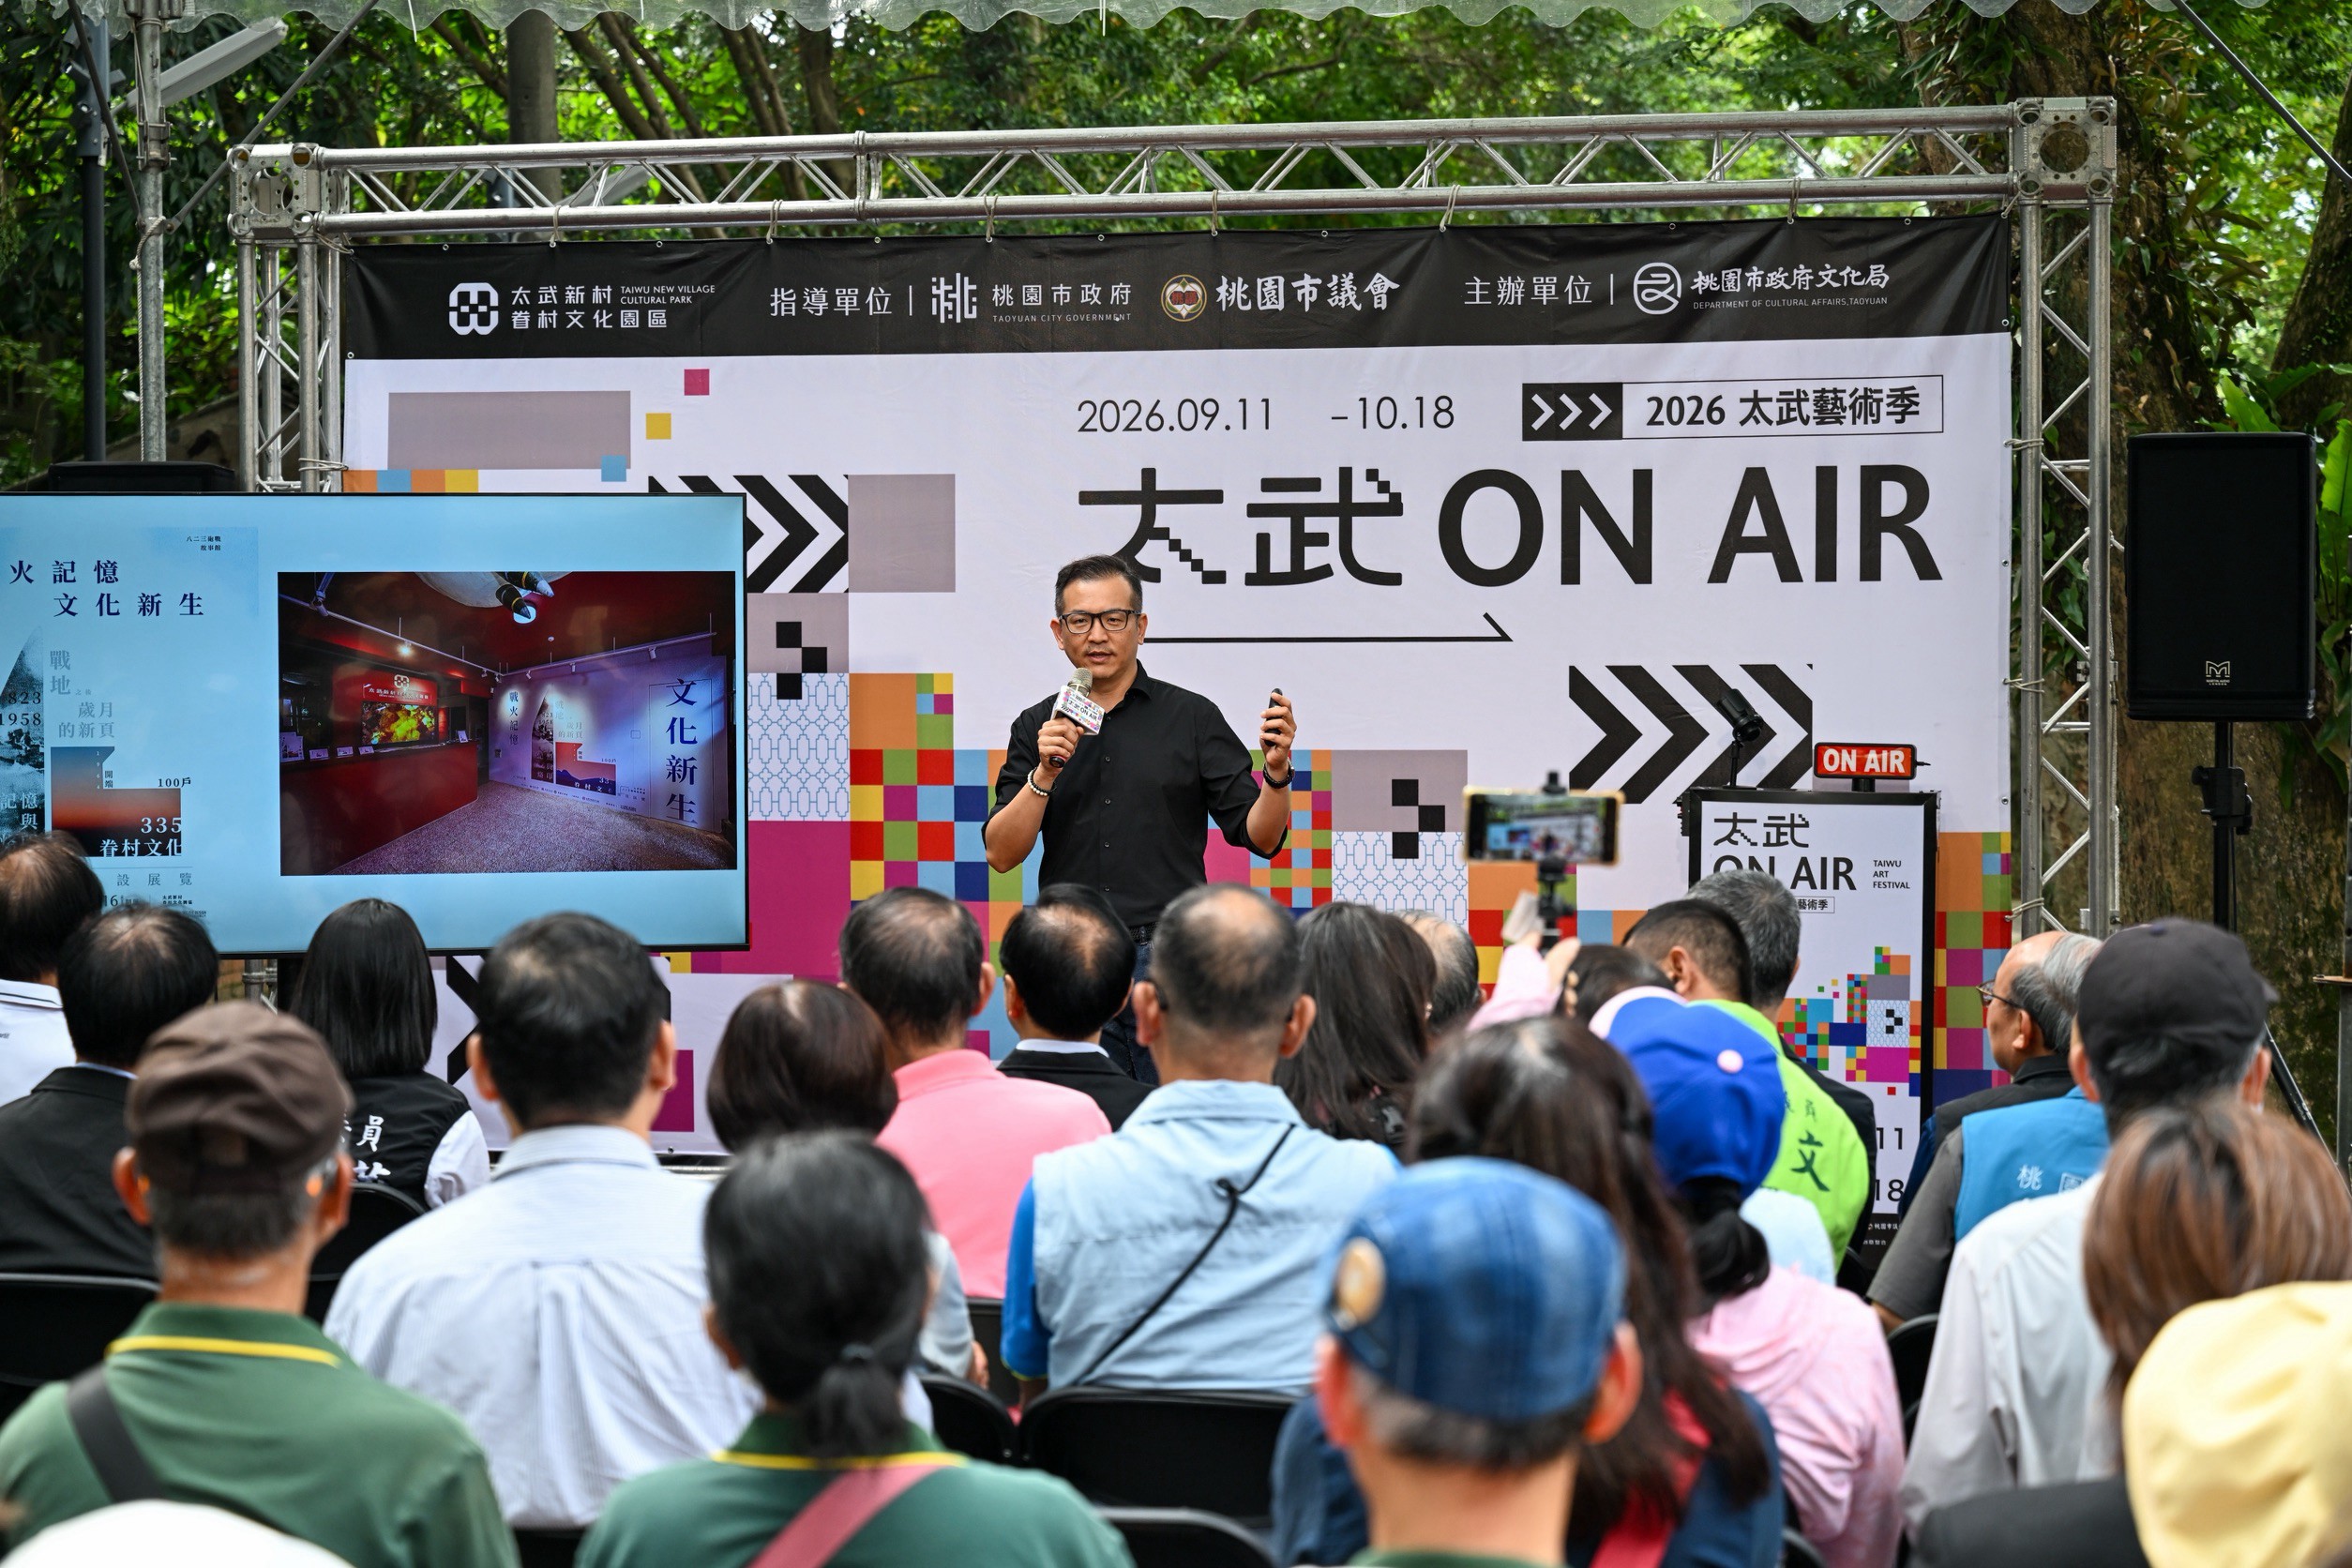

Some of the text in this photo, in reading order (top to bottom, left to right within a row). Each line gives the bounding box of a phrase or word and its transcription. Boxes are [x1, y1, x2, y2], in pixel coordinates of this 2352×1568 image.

[621, 284, 716, 294] TAIWU NEW VILLAGE
[1215, 272, 1400, 312] 桃園市議會
[1464, 276, 1592, 306] 主辦單位
[1690, 264, 1890, 295] 桃園市政府文化局
[511, 285, 612, 305] 太武新村
[620, 295, 693, 305] CULTURAL PARK
[770, 287, 892, 317] 指導單位
[992, 282, 1132, 307] 桃園市政府
[1693, 300, 1749, 309] DEPARTMENT
[1765, 299, 1809, 308] CULTURAL
[511, 309, 668, 329] 眷村文化園區
[1041, 314, 1063, 323] CITY
[1065, 313, 1132, 322] GOVERNMENT
[1078, 398, 1271, 433] 2026.09.11
[1646, 385, 1921, 427] 2026 太武藝術季
[1078, 463, 1943, 588] 太武 ON AIR
[9, 559, 119, 584] 火記憶
[53, 593, 204, 617] 文化新生
[8, 692, 41, 704] 823
[58, 722, 114, 739] 的新頁
[666, 678, 698, 824] 文化新生
[1823, 748, 1905, 774] ON AIR
[1713, 812, 1810, 848] 太武
[1790, 856, 1857, 890] AIR
[1873, 859, 1902, 868] TAIWU
[1873, 870, 1889, 879] ART
